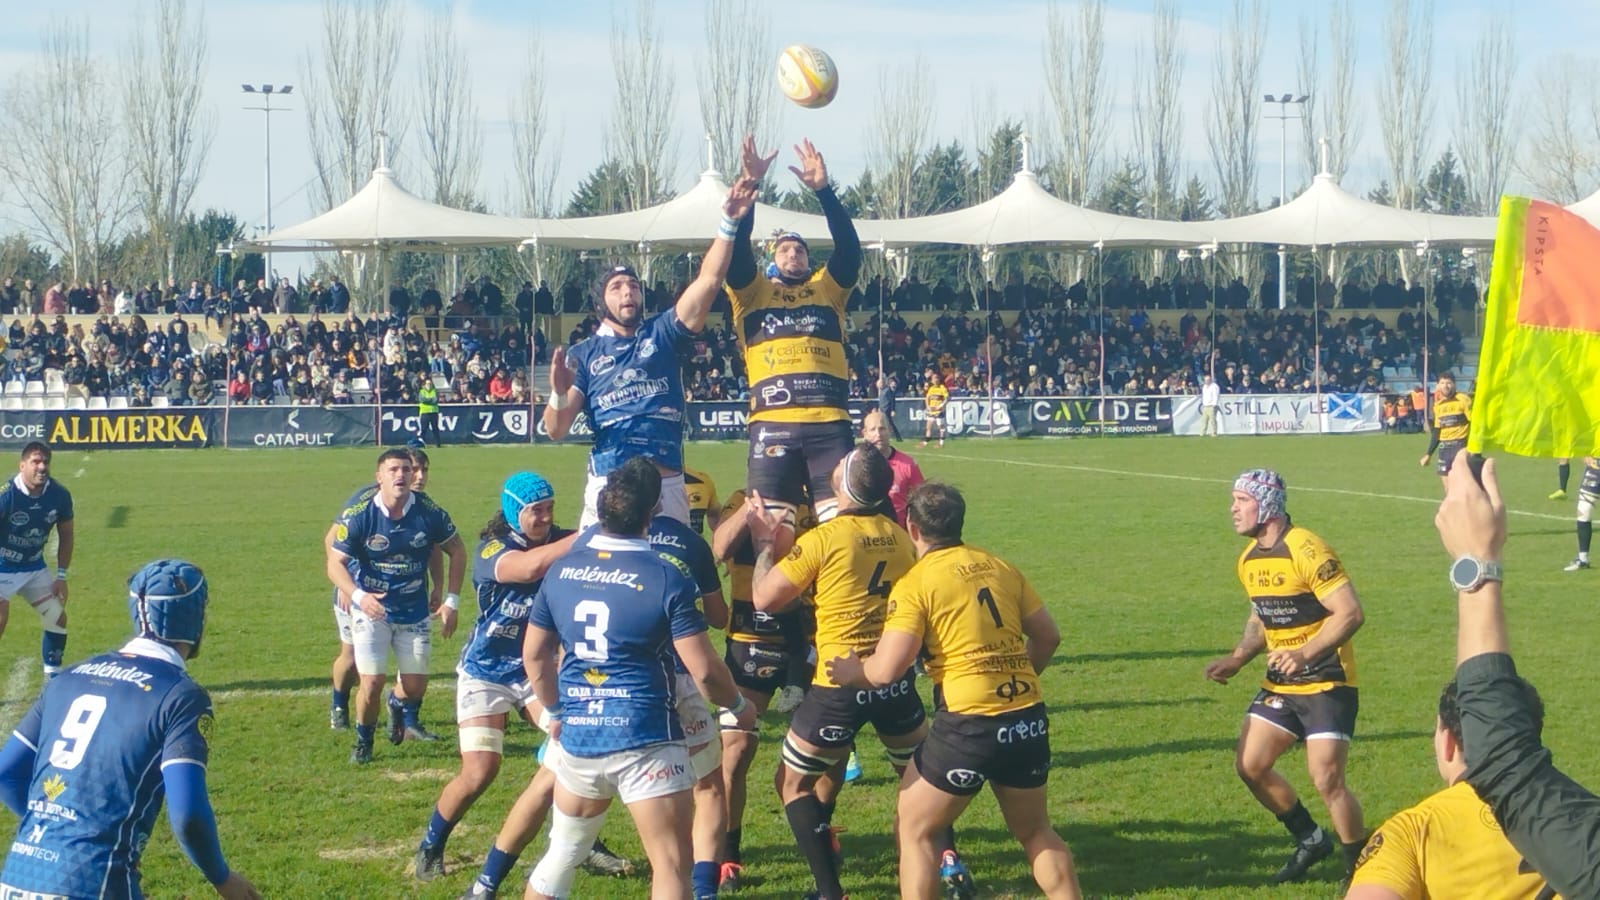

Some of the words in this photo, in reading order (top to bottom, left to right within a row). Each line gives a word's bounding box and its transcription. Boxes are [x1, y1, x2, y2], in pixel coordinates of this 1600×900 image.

[1534, 215, 1549, 275] KIPSTA
[1, 424, 44, 438] COPE
[49, 414, 207, 444] ALIMERKA
[404, 412, 458, 436] cytv
[478, 411, 493, 432] 7
[700, 410, 750, 426] UEM
[945, 400, 1011, 434] gaza
[254, 432, 335, 446] CATAPULT
[867, 560, 891, 599] 4
[976, 586, 1004, 628] 1
[573, 599, 610, 663] 3
[49, 693, 108, 770] 9
